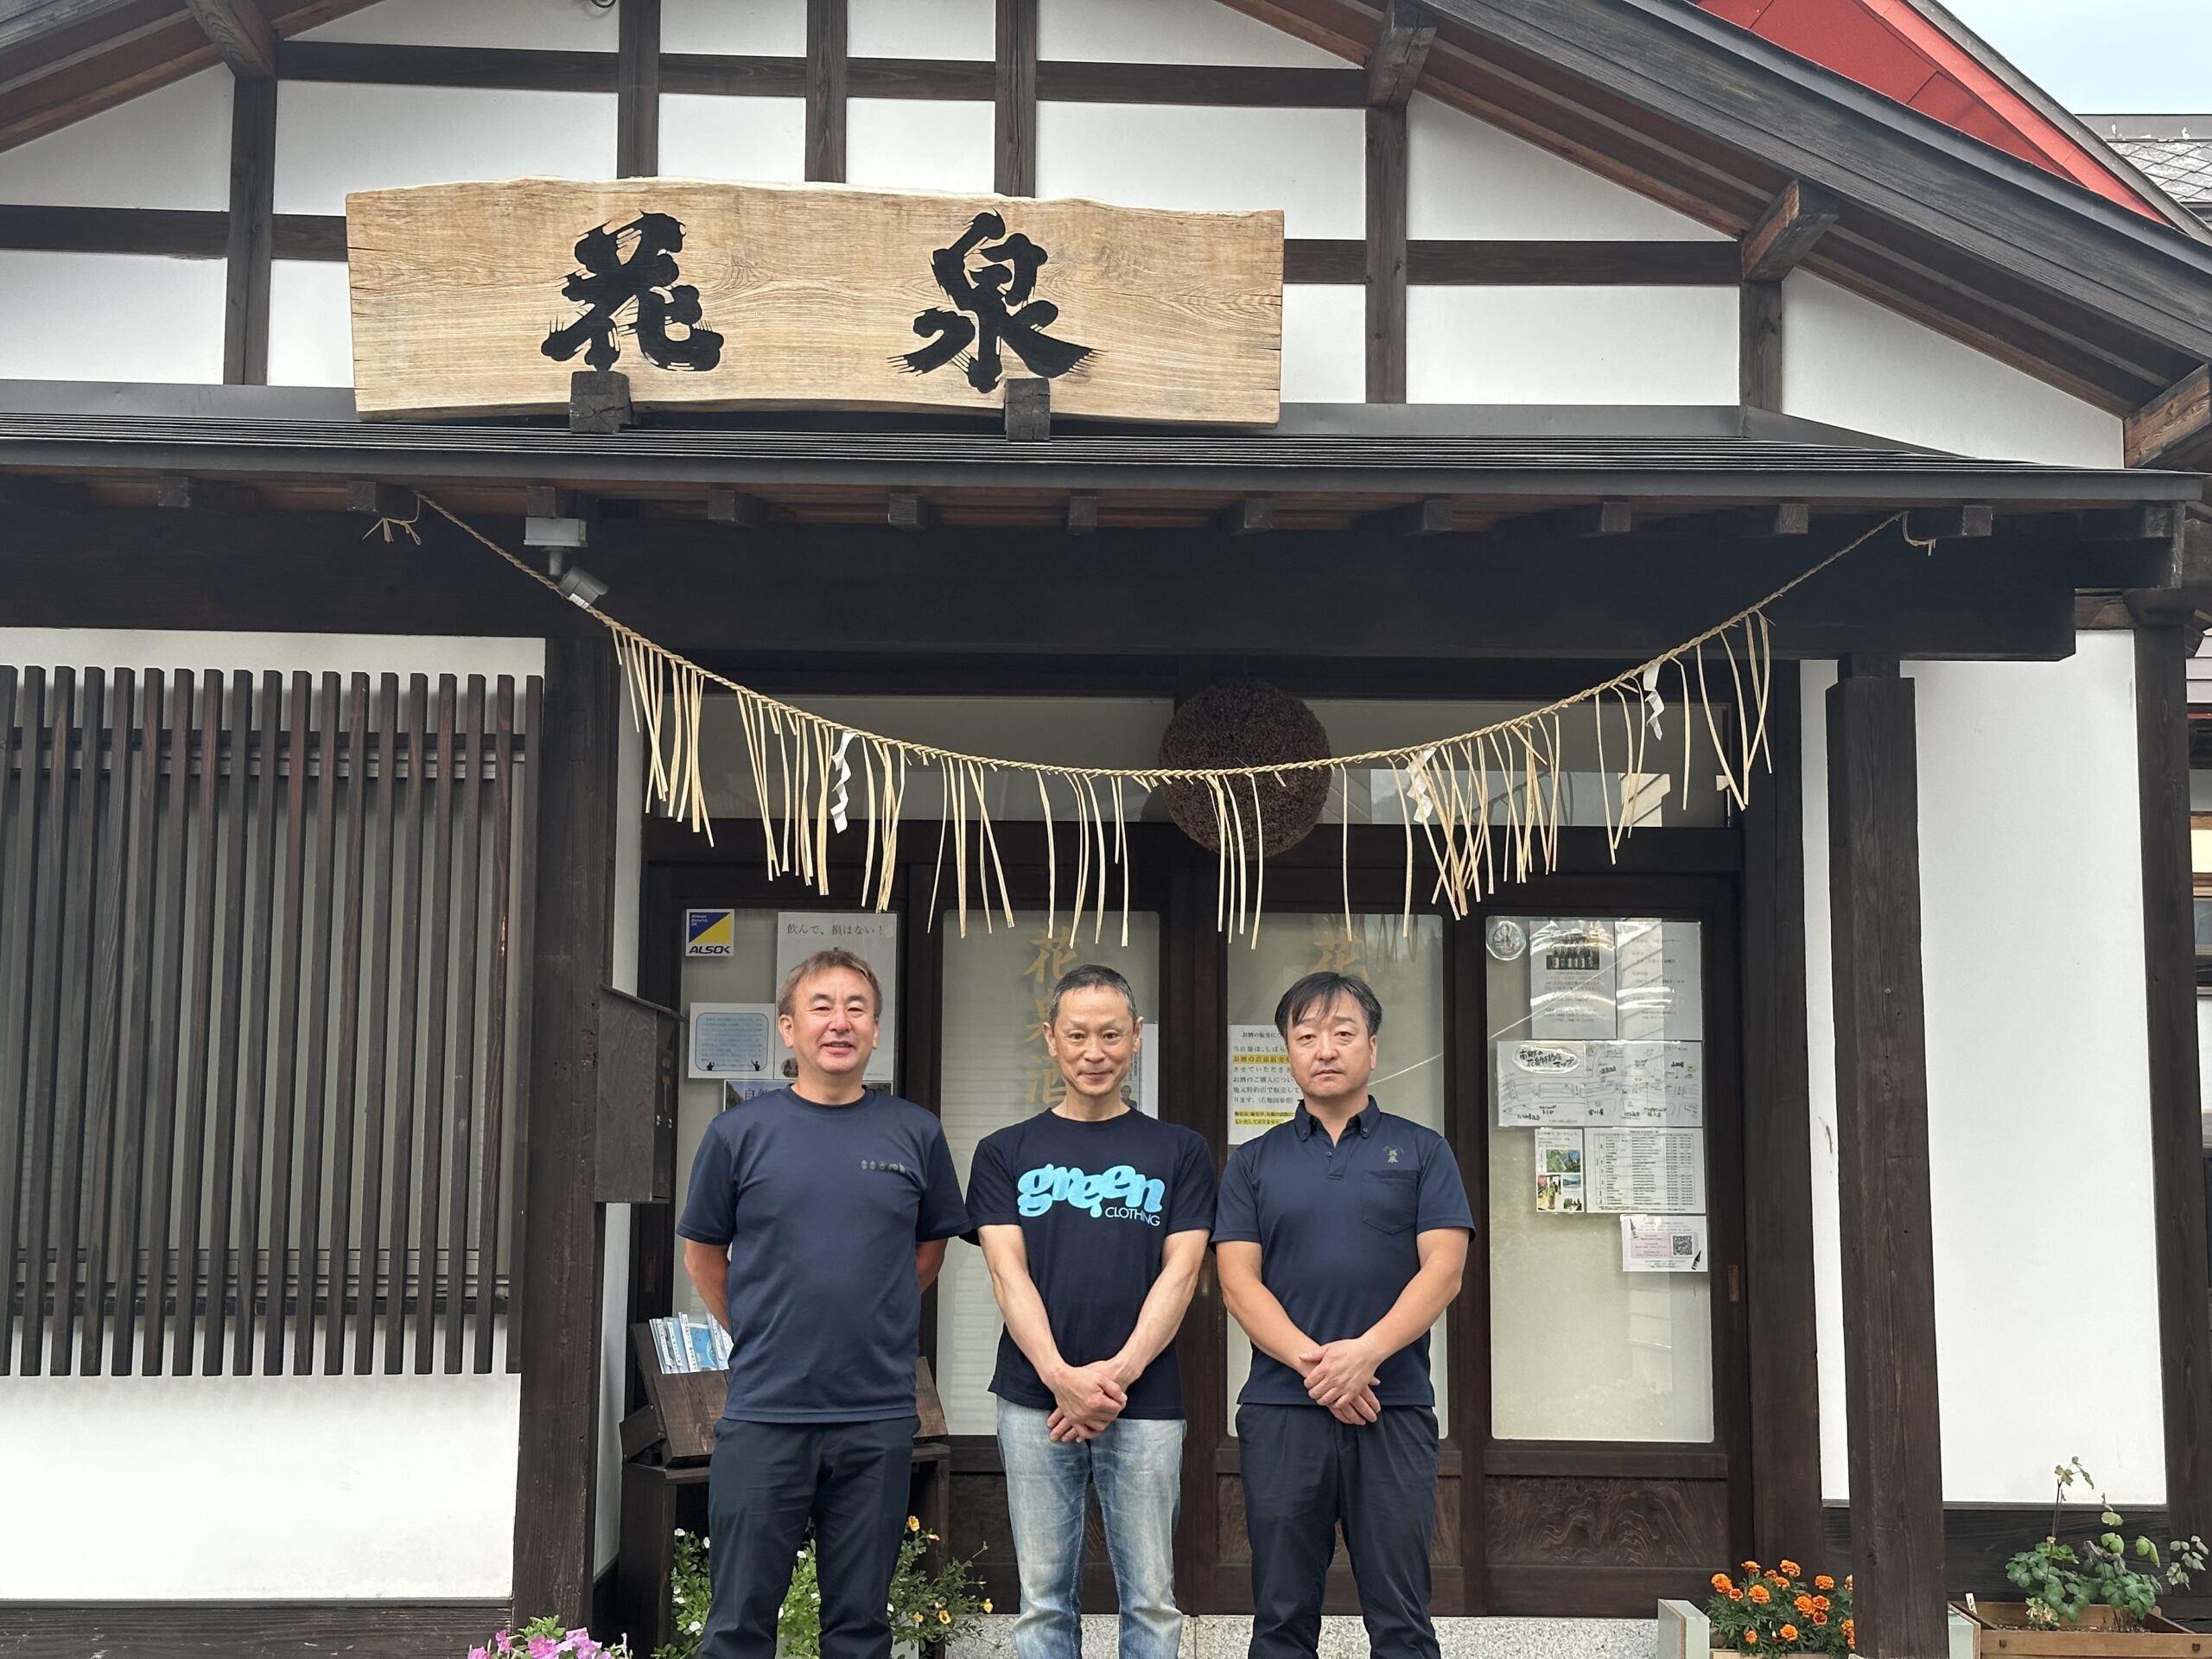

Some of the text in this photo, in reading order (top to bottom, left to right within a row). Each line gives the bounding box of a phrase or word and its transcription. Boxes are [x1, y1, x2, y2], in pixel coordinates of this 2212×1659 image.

[540, 208, 1104, 393] 花泉
[690, 945, 730, 954] ALSOK
[1017, 1163, 1166, 1217] green
[1105, 1206, 1160, 1227] CLOTHING
